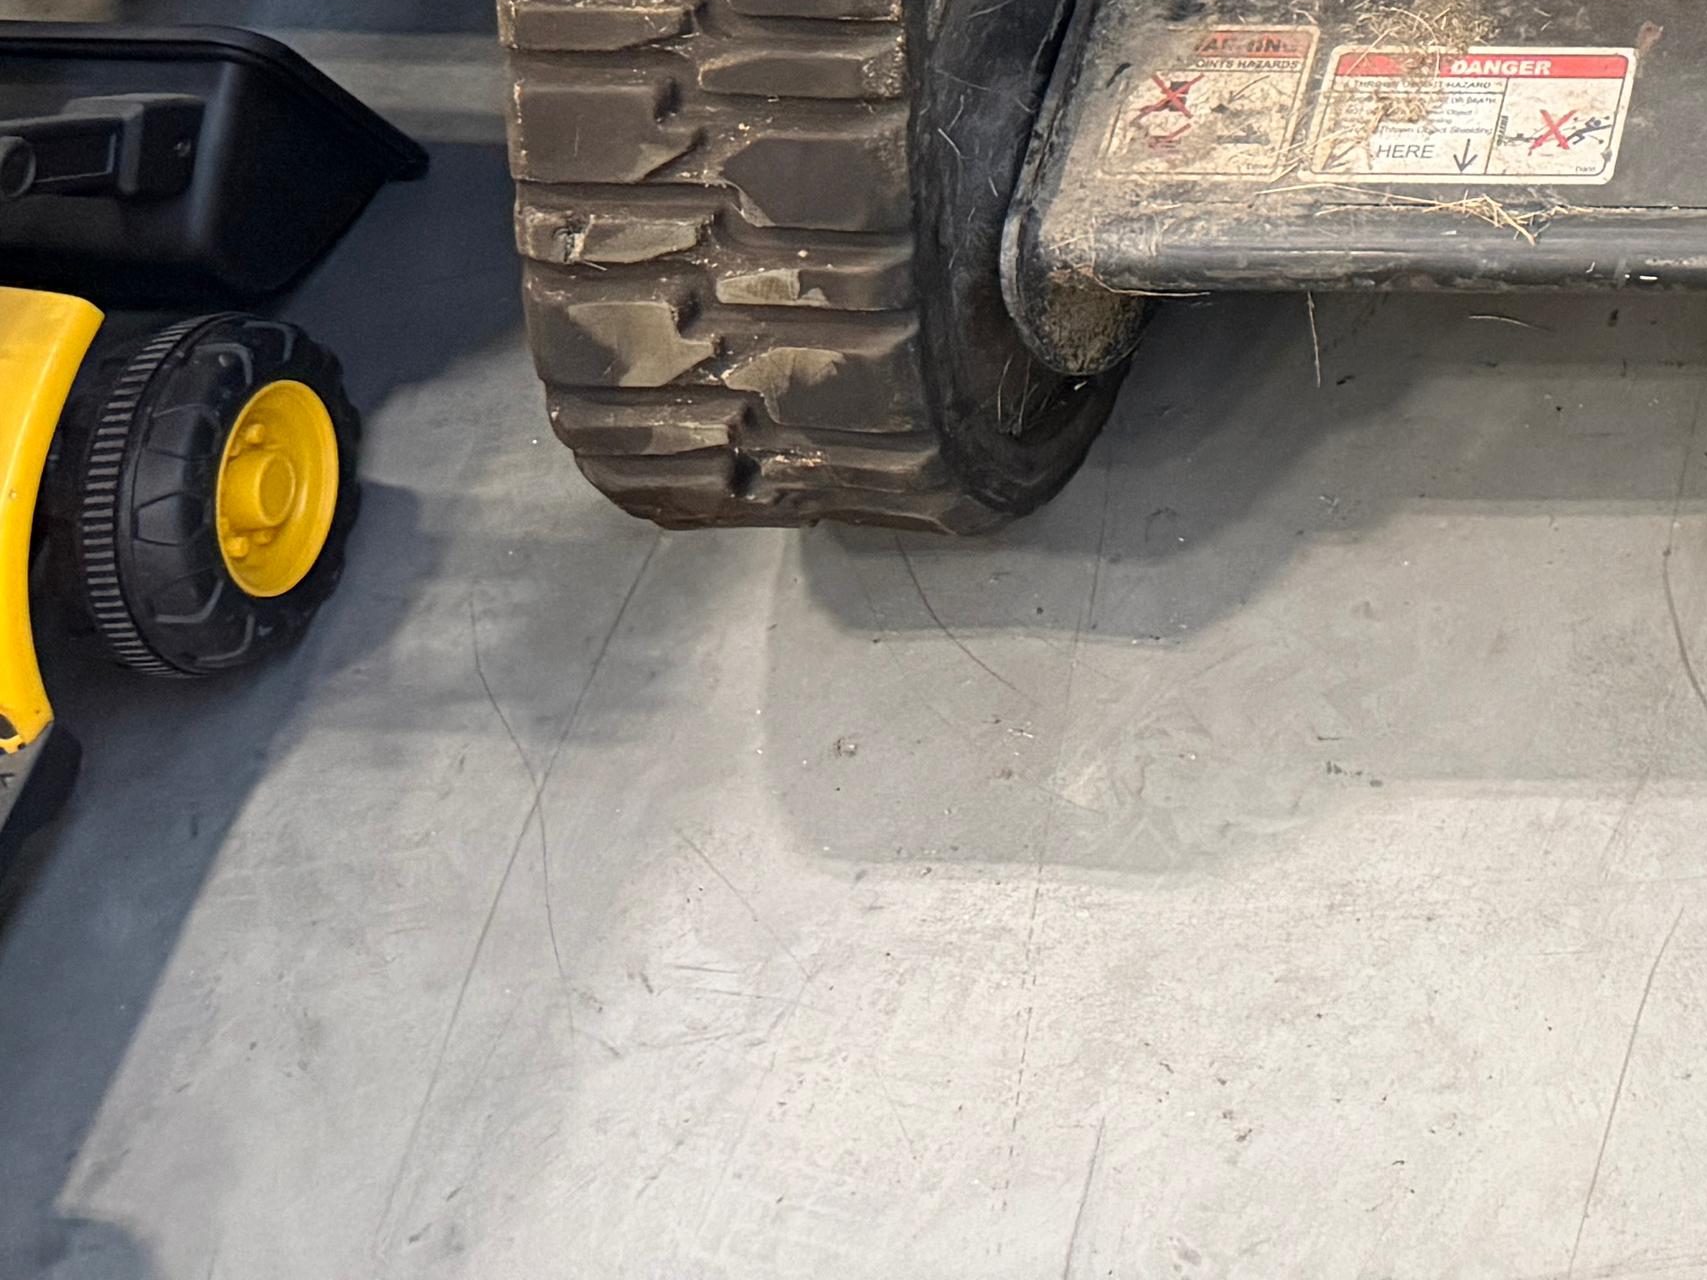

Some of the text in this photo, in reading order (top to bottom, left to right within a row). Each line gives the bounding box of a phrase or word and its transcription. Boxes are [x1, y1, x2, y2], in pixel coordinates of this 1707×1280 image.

[1196, 59, 1299, 69] OINTS HAZARDS
[1450, 59, 1552, 76] DANGER
[1375, 143, 1435, 159] HERE
